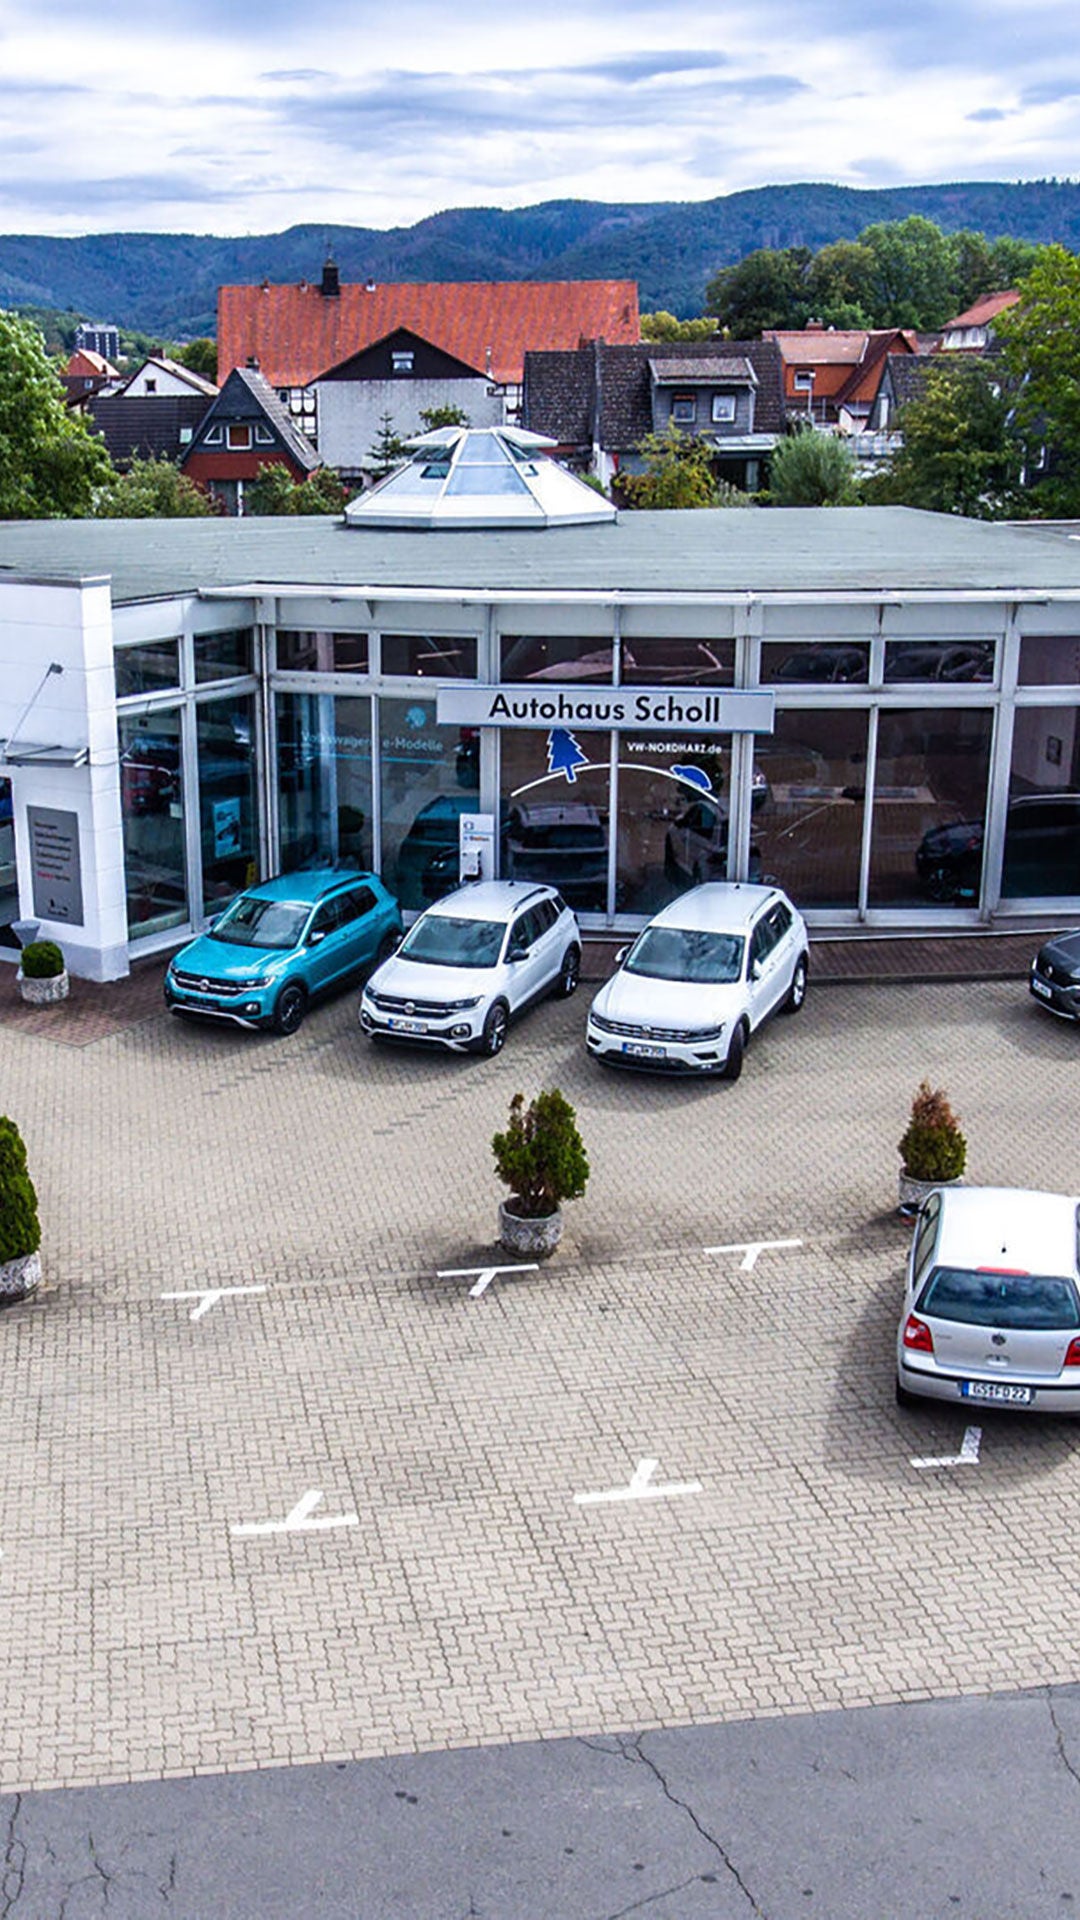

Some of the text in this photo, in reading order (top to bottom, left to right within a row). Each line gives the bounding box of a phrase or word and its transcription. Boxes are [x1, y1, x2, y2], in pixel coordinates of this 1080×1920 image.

[489, 693, 720, 723] Autohaus Scholl
[382, 736, 443, 752] e-Modelle
[627, 741, 722, 755] VW-NORDHARZ.de
